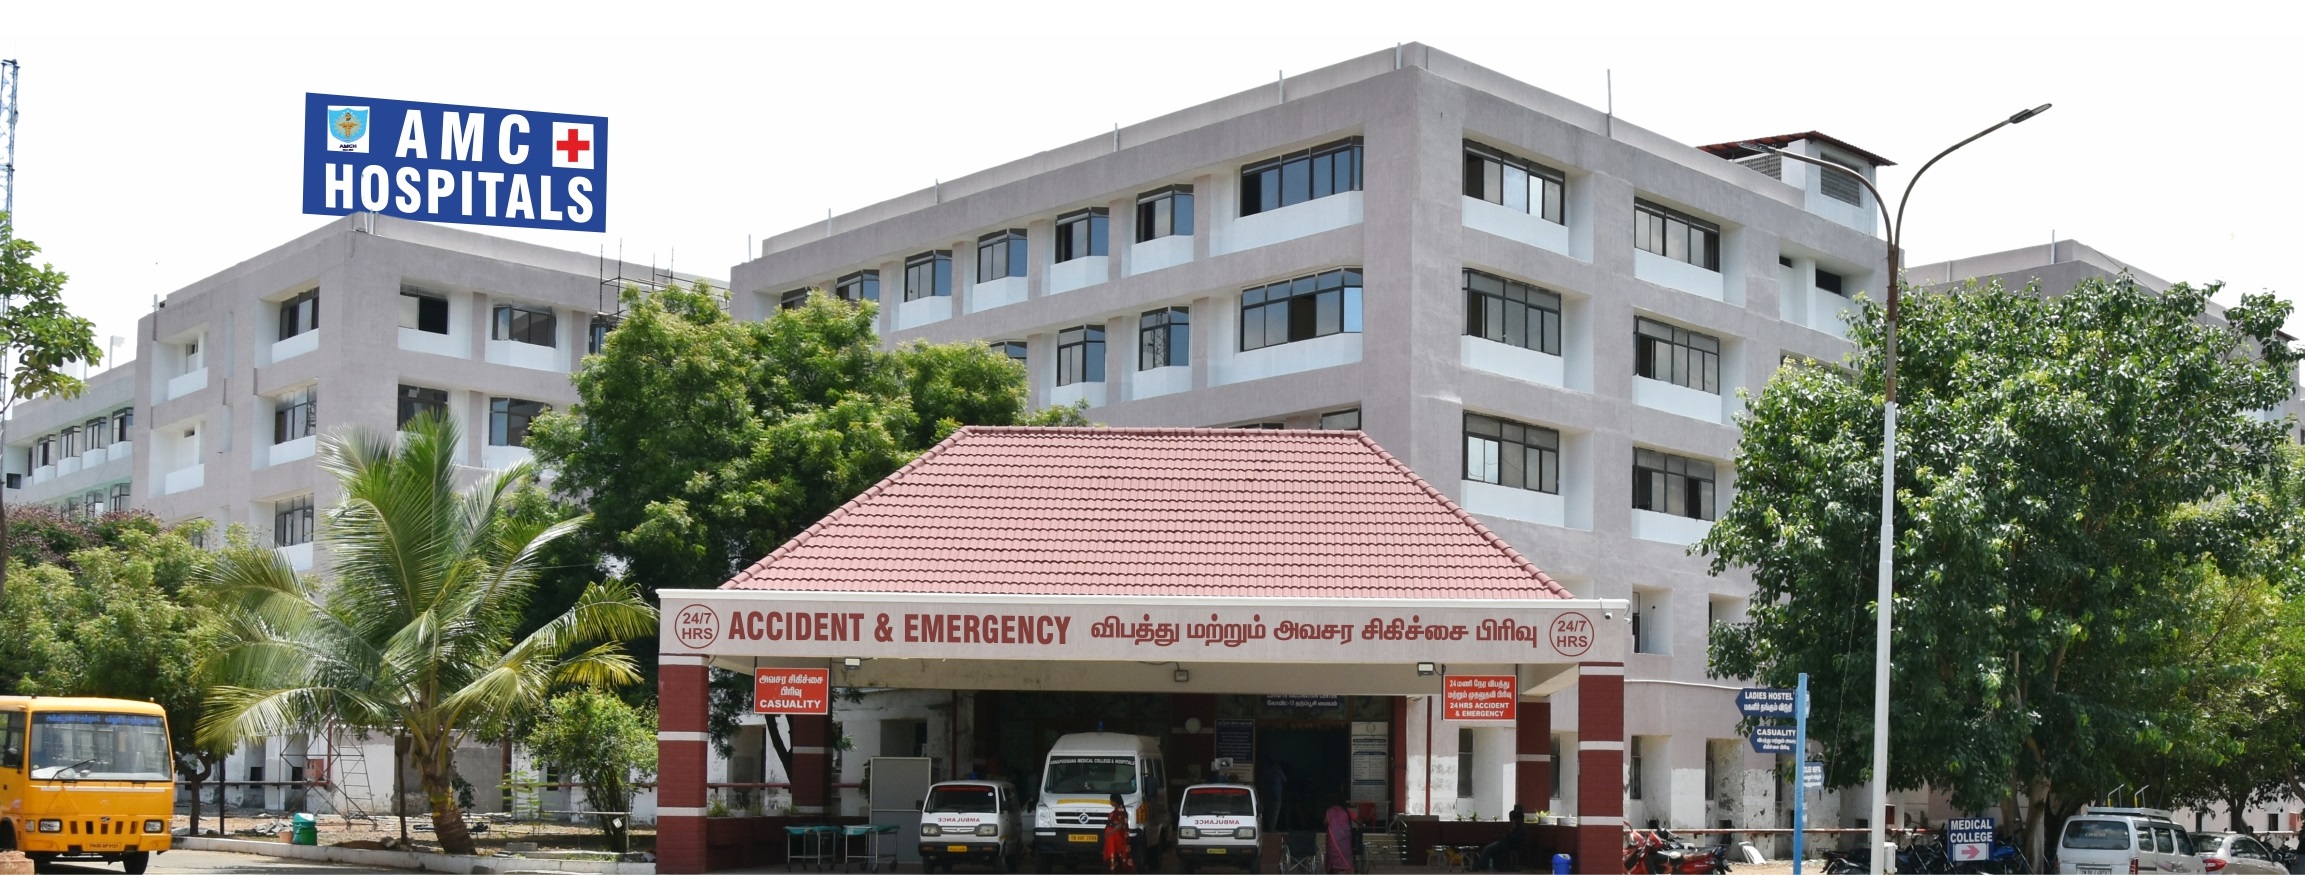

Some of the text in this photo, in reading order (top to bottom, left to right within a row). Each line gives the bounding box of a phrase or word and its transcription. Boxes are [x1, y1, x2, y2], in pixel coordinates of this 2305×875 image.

[395, 109, 530, 165] AMC
[325, 163, 593, 224] HOSPITALS
[682, 612, 712, 625] 24/7
[728, 611, 1071, 644] ACCIDENT & EMERGENCY
[1091, 613, 1537, 648] விபத்து மற்றும் அவசர சிகிச்சை பிரிவு
[1557, 620, 1587, 633] 24/7
[681, 628, 713, 640] HRS
[1556, 635, 1588, 648] HRS
[759, 673, 823, 685] அவசர சிகிச்சை
[781, 686, 802, 698] பிரிவு
[1745, 692, 1794, 700] LADIES HOSTEL
[760, 699, 821, 709] CASUALITY
[1950, 819, 1992, 830] MEDICAL
[1950, 832, 1993, 843] COLLEGE
